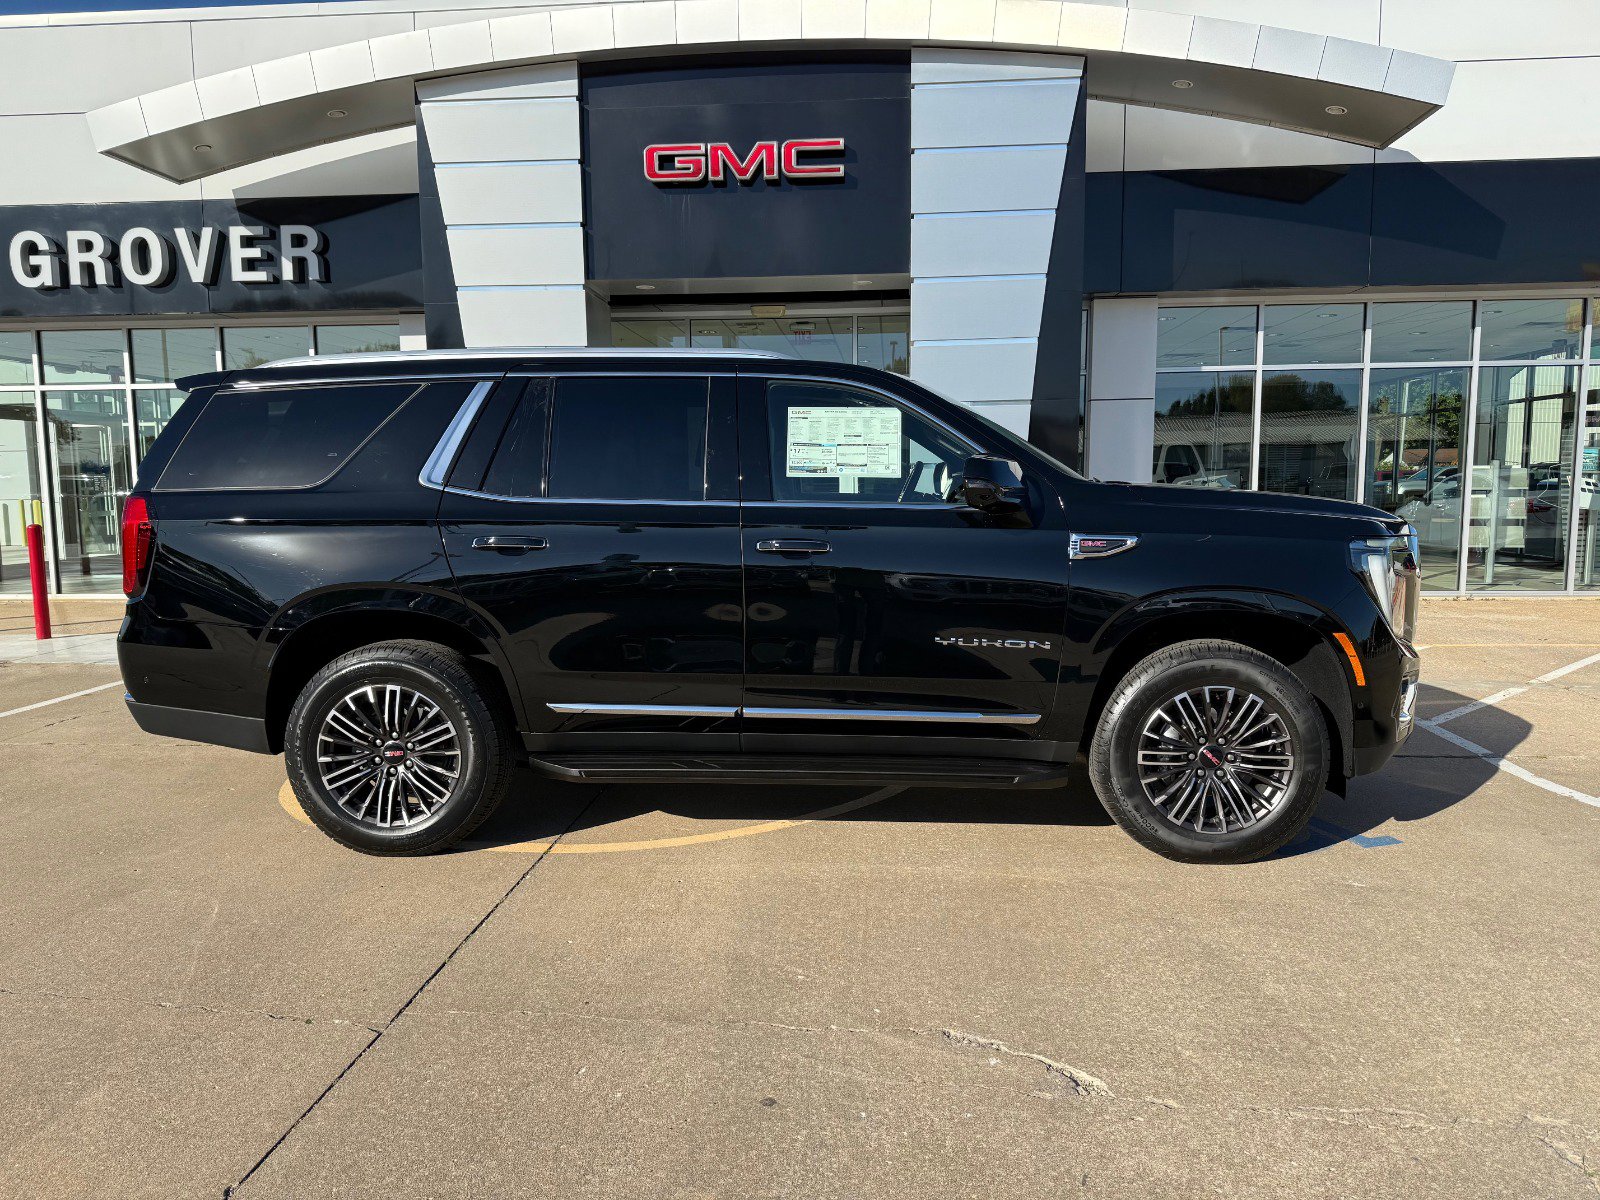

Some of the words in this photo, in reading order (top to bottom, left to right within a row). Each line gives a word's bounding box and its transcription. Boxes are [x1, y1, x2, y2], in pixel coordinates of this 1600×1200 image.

[643, 138, 845, 181] GMC
[9, 224, 322, 288] GROVER
[934, 637, 1051, 649] YUKON
